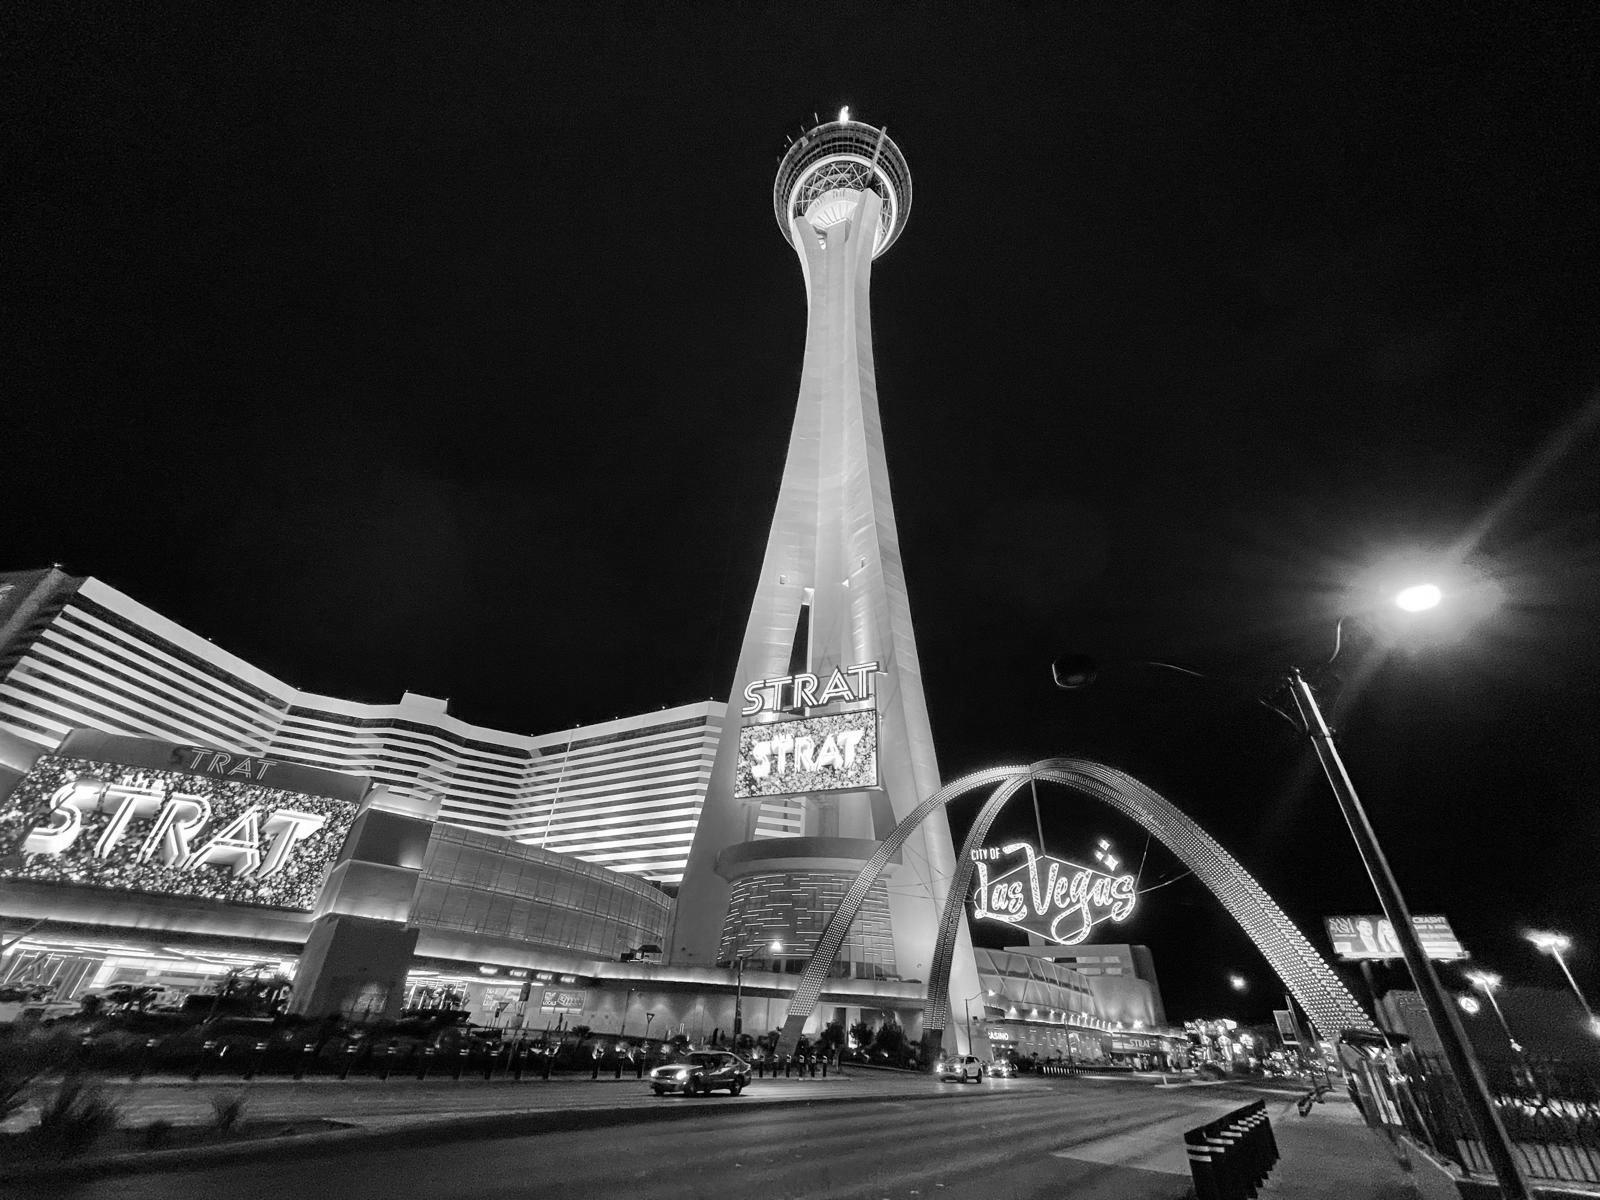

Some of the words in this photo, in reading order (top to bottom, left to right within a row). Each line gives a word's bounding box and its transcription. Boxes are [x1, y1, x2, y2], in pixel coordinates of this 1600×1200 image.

[742, 661, 879, 717] STRAT
[752, 728, 865, 778] STRAT
[23, 781, 326, 879] STRAT
[971, 848, 988, 861] CITY
[990, 847, 1001, 860] OF
[974, 861, 1028, 923] Las
[1001, 842, 1136, 946] Vegas
